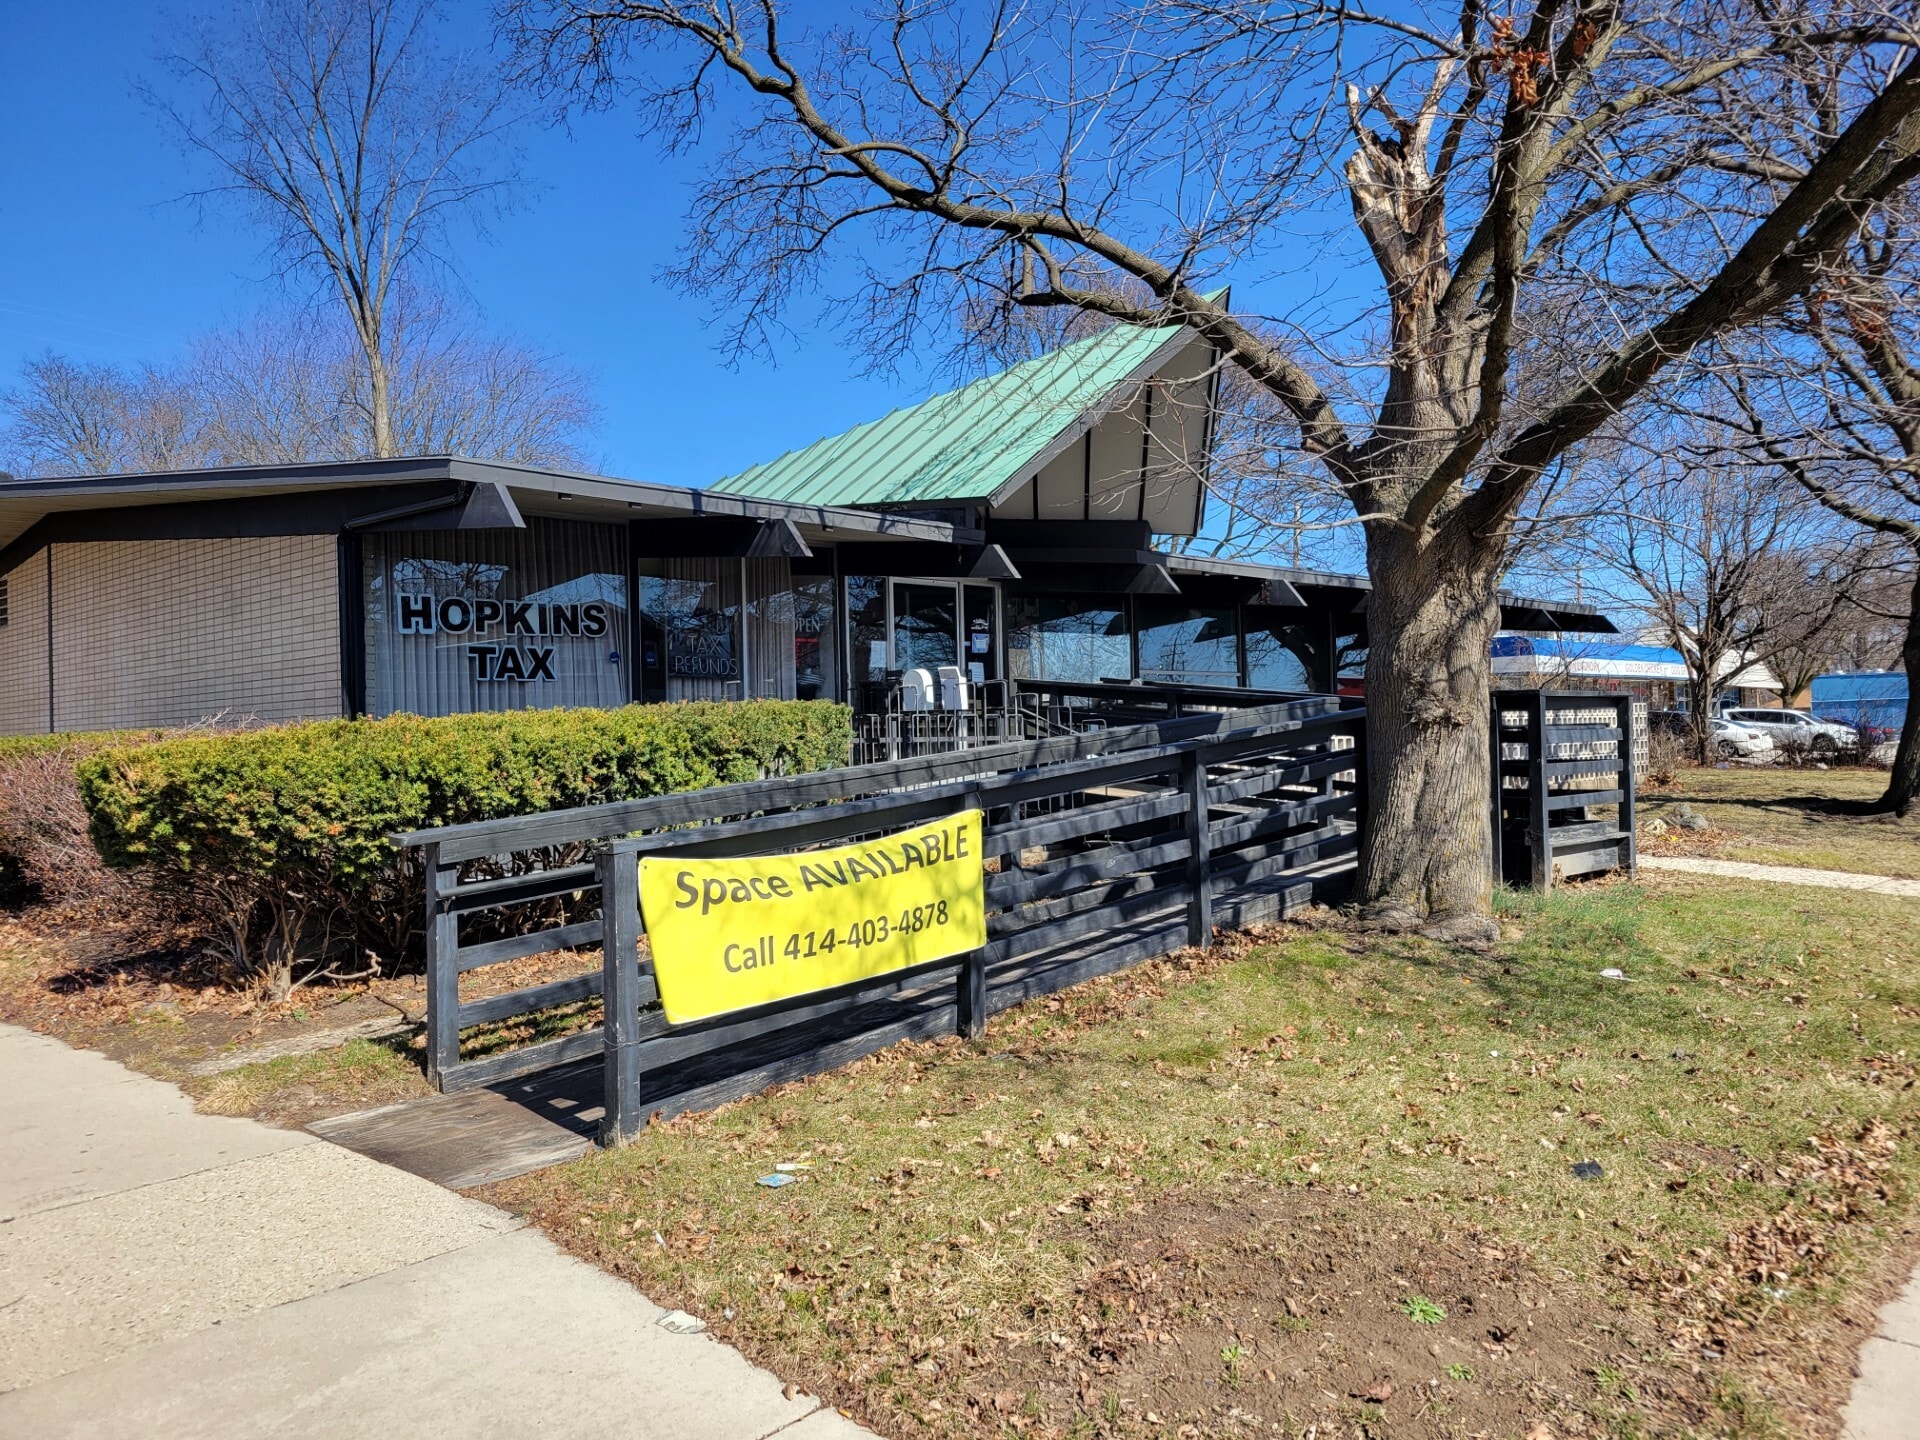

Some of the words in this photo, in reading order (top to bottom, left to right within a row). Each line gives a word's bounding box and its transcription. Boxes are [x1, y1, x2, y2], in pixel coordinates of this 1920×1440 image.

[399, 594, 608, 637] HOPKINS
[467, 645, 559, 682] TAX
[687, 635, 722, 654] TAX
[675, 655, 738, 676] REFUNDS
[674, 870, 793, 915] Space
[800, 824, 969, 892] AVAILABLE
[723, 935, 775, 973] Call
[784, 899, 949, 961] 414-403-4878
